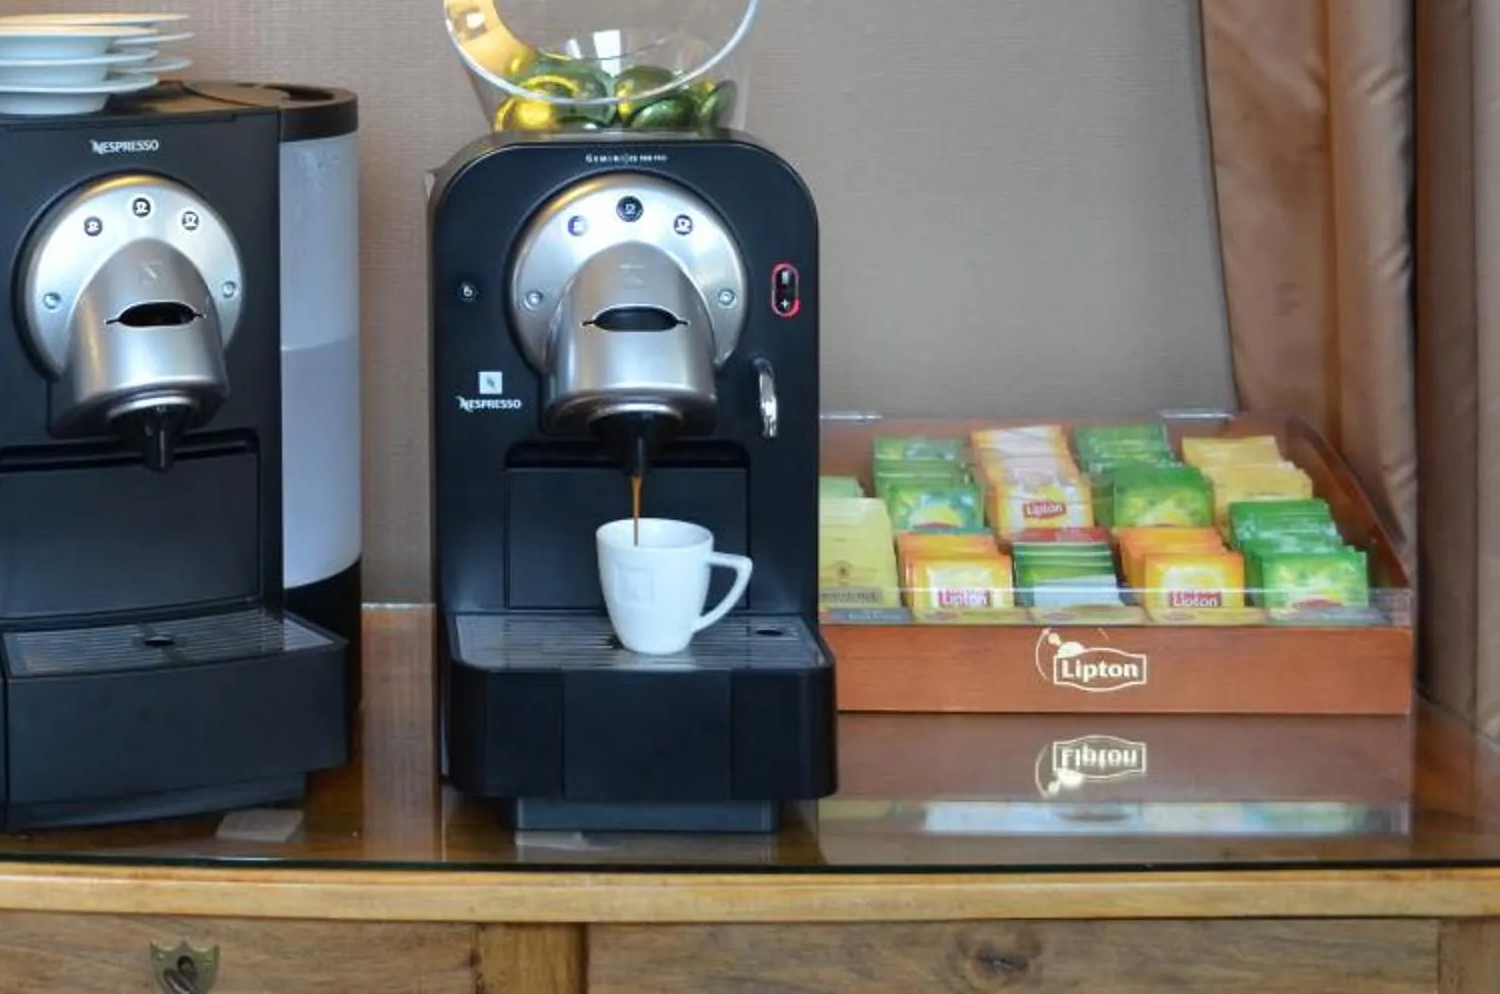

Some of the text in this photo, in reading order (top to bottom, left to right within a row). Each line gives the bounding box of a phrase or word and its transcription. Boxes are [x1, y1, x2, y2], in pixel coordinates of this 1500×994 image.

[89, 139, 159, 155] NESPRESSO
[455, 395, 522, 413] NESPRESSO
[1172, 591, 1219, 607] Lipton
[1061, 659, 1139, 683] Lipton
